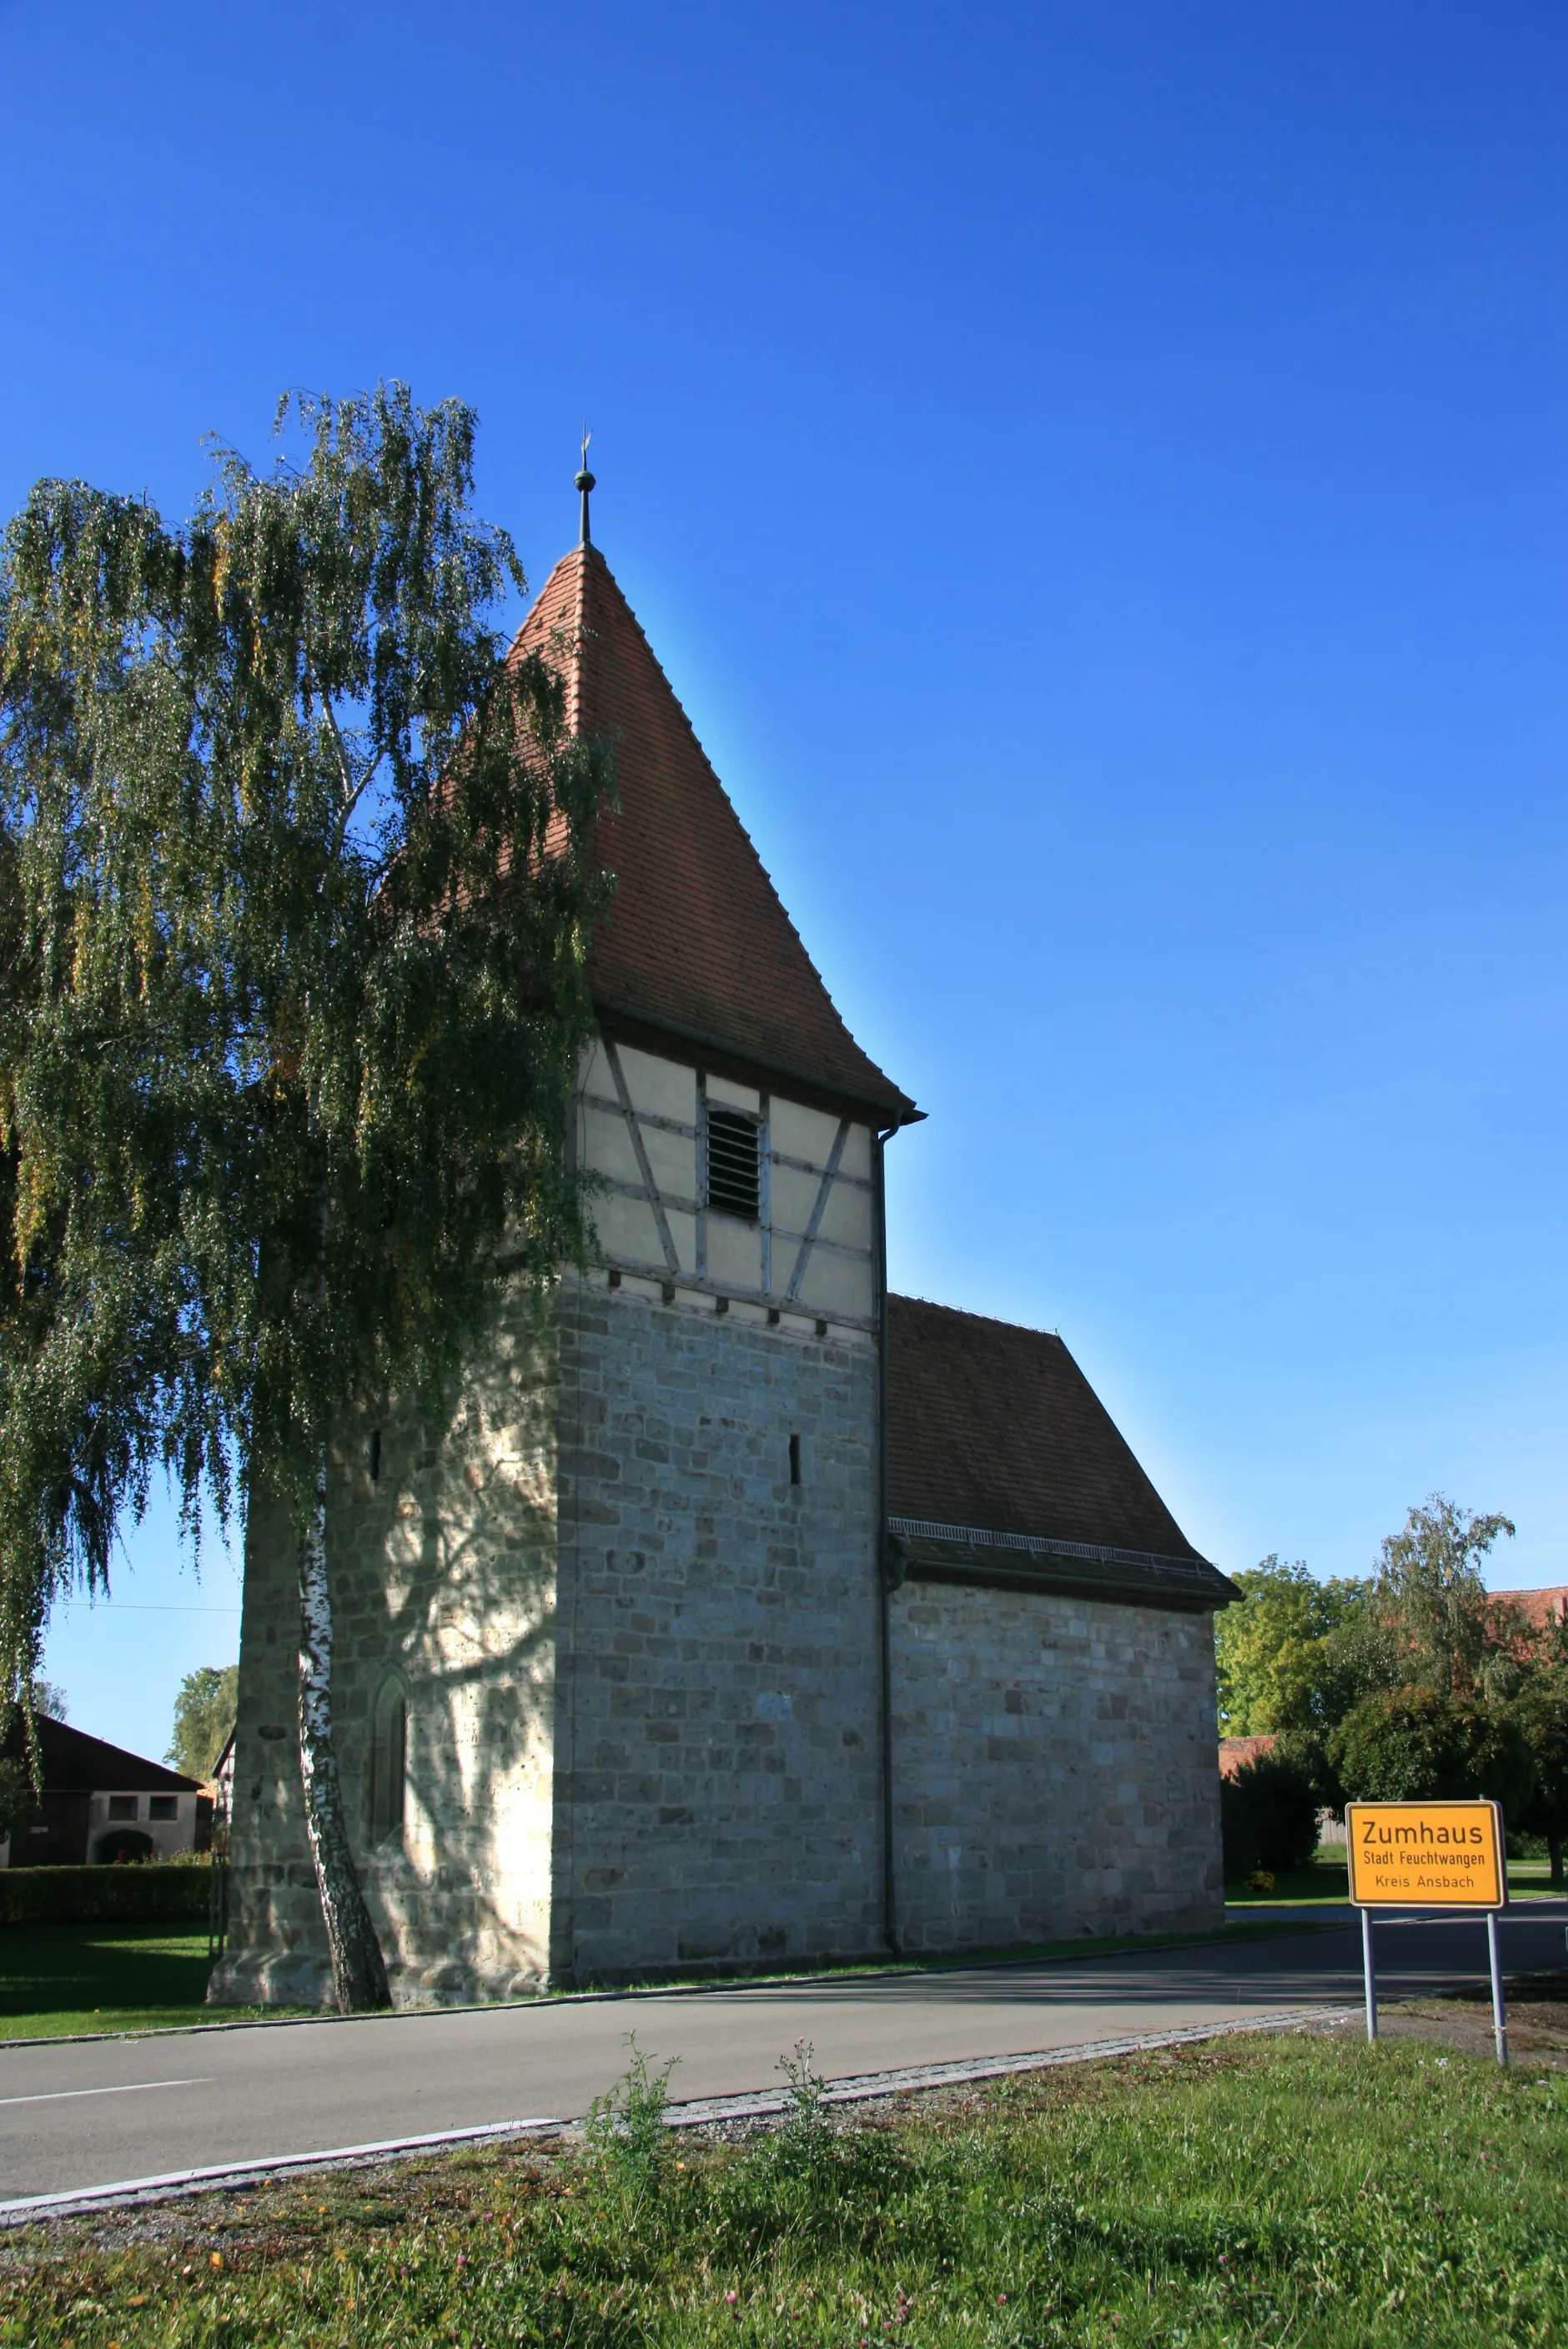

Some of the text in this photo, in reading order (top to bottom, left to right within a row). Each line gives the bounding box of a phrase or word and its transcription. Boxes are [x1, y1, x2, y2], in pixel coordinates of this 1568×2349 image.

[1362, 1821, 1483, 1844] Zumhaus
[1364, 1851, 1485, 1869] Stadt Feuchtwangen
[1375, 1875, 1475, 1888] Kreis Ansbach
